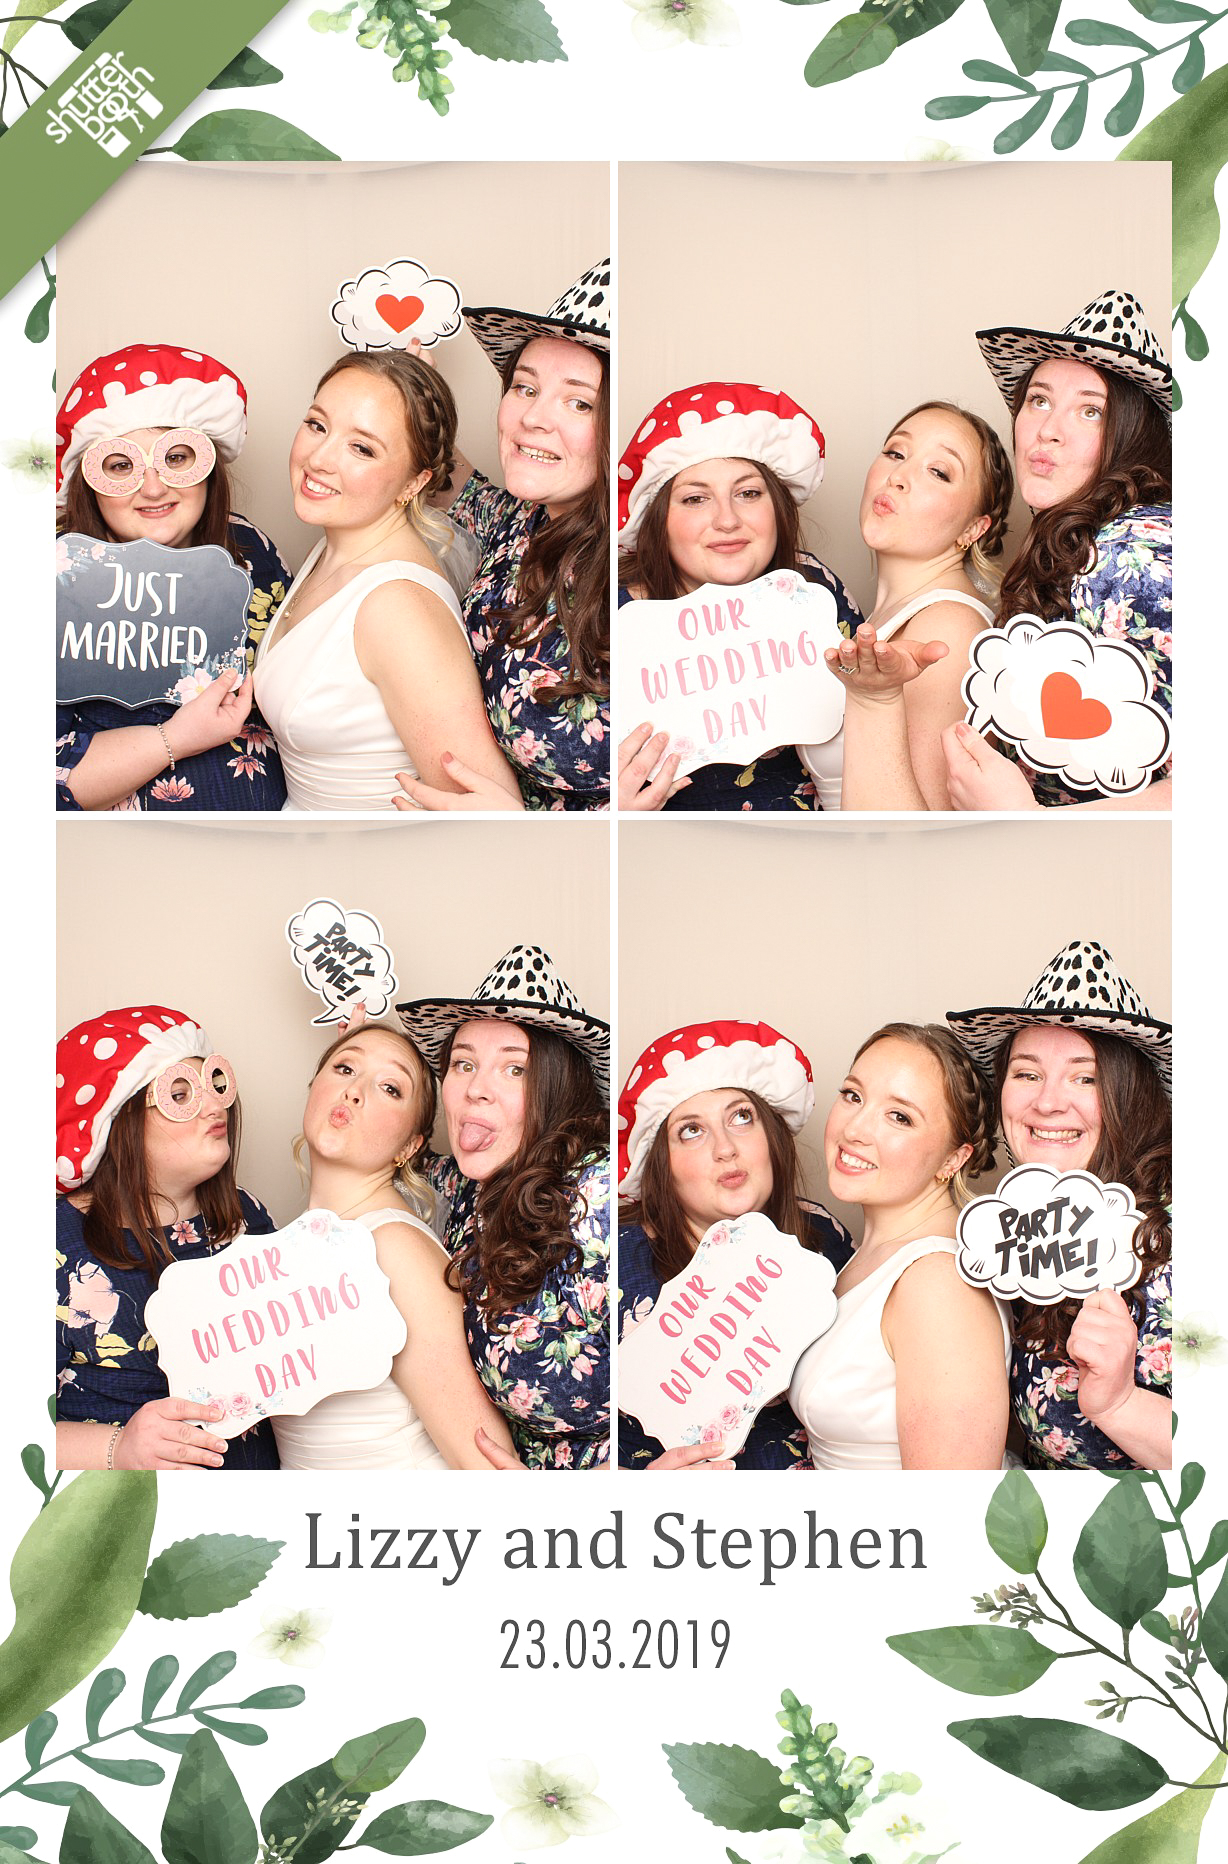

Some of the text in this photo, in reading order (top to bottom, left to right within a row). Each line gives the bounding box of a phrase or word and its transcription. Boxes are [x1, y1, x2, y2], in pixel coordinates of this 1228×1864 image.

[96, 562, 183, 617] JUST
[60, 620, 208, 672] MARRIED
[677, 598, 750, 641] OUR
[641, 630, 817, 704] WEDDING
[702, 694, 767, 745] DAY
[325, 922, 375, 977] PARTY
[998, 1196, 1094, 1242] PARTY
[218, 1246, 290, 1297] OUR
[191, 1272, 361, 1364] WEDDING
[659, 1274, 716, 1338] OUR
[659, 1254, 783, 1405] WEDDING
[254, 1343, 317, 1398] DAY
[725, 1325, 781, 1396] DAY
